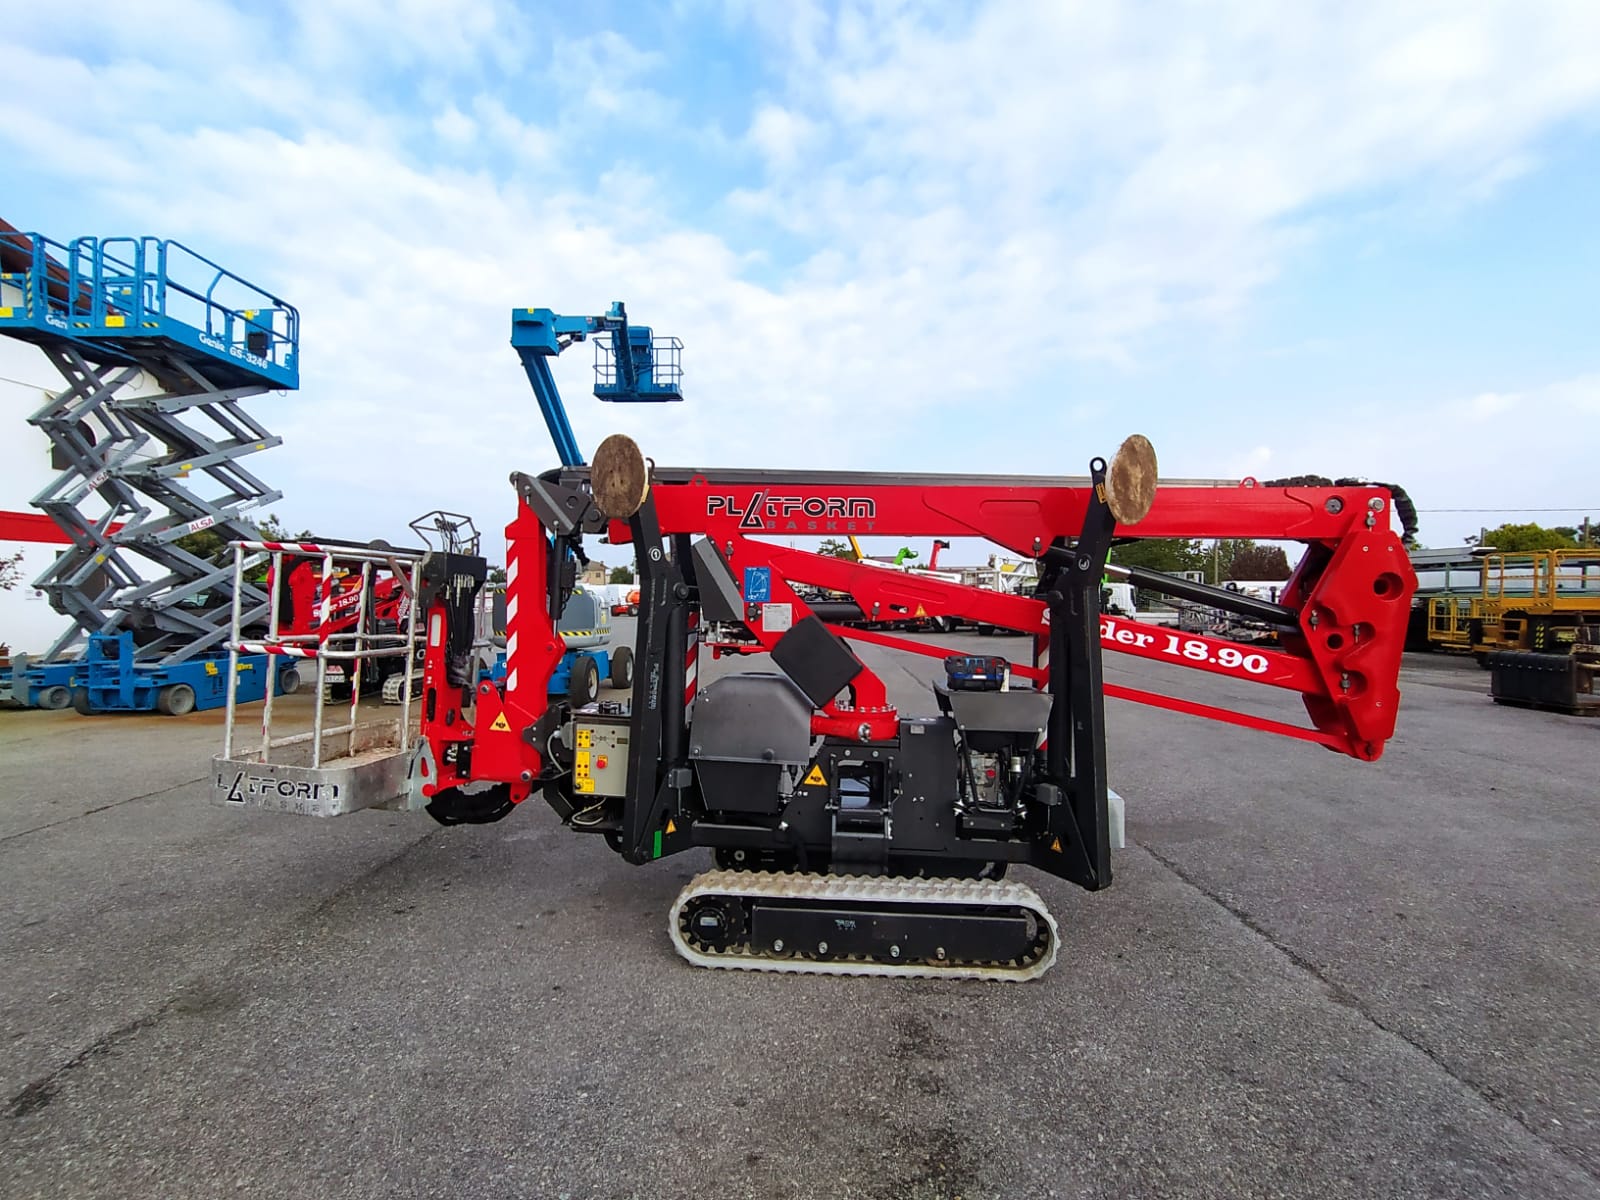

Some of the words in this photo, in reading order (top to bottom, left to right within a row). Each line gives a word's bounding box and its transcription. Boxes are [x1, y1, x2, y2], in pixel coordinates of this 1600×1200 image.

[45, 314, 68, 330] Gen
[229, 346, 268, 369] GS-3246
[707, 489, 876, 529] PLATFORM
[191, 518, 214, 532] ALSA
[766, 521, 875, 530] BASKET
[338, 595, 358, 608] 18.90
[1041, 608, 1154, 648] Sder
[1163, 634, 1269, 674] 18.90
